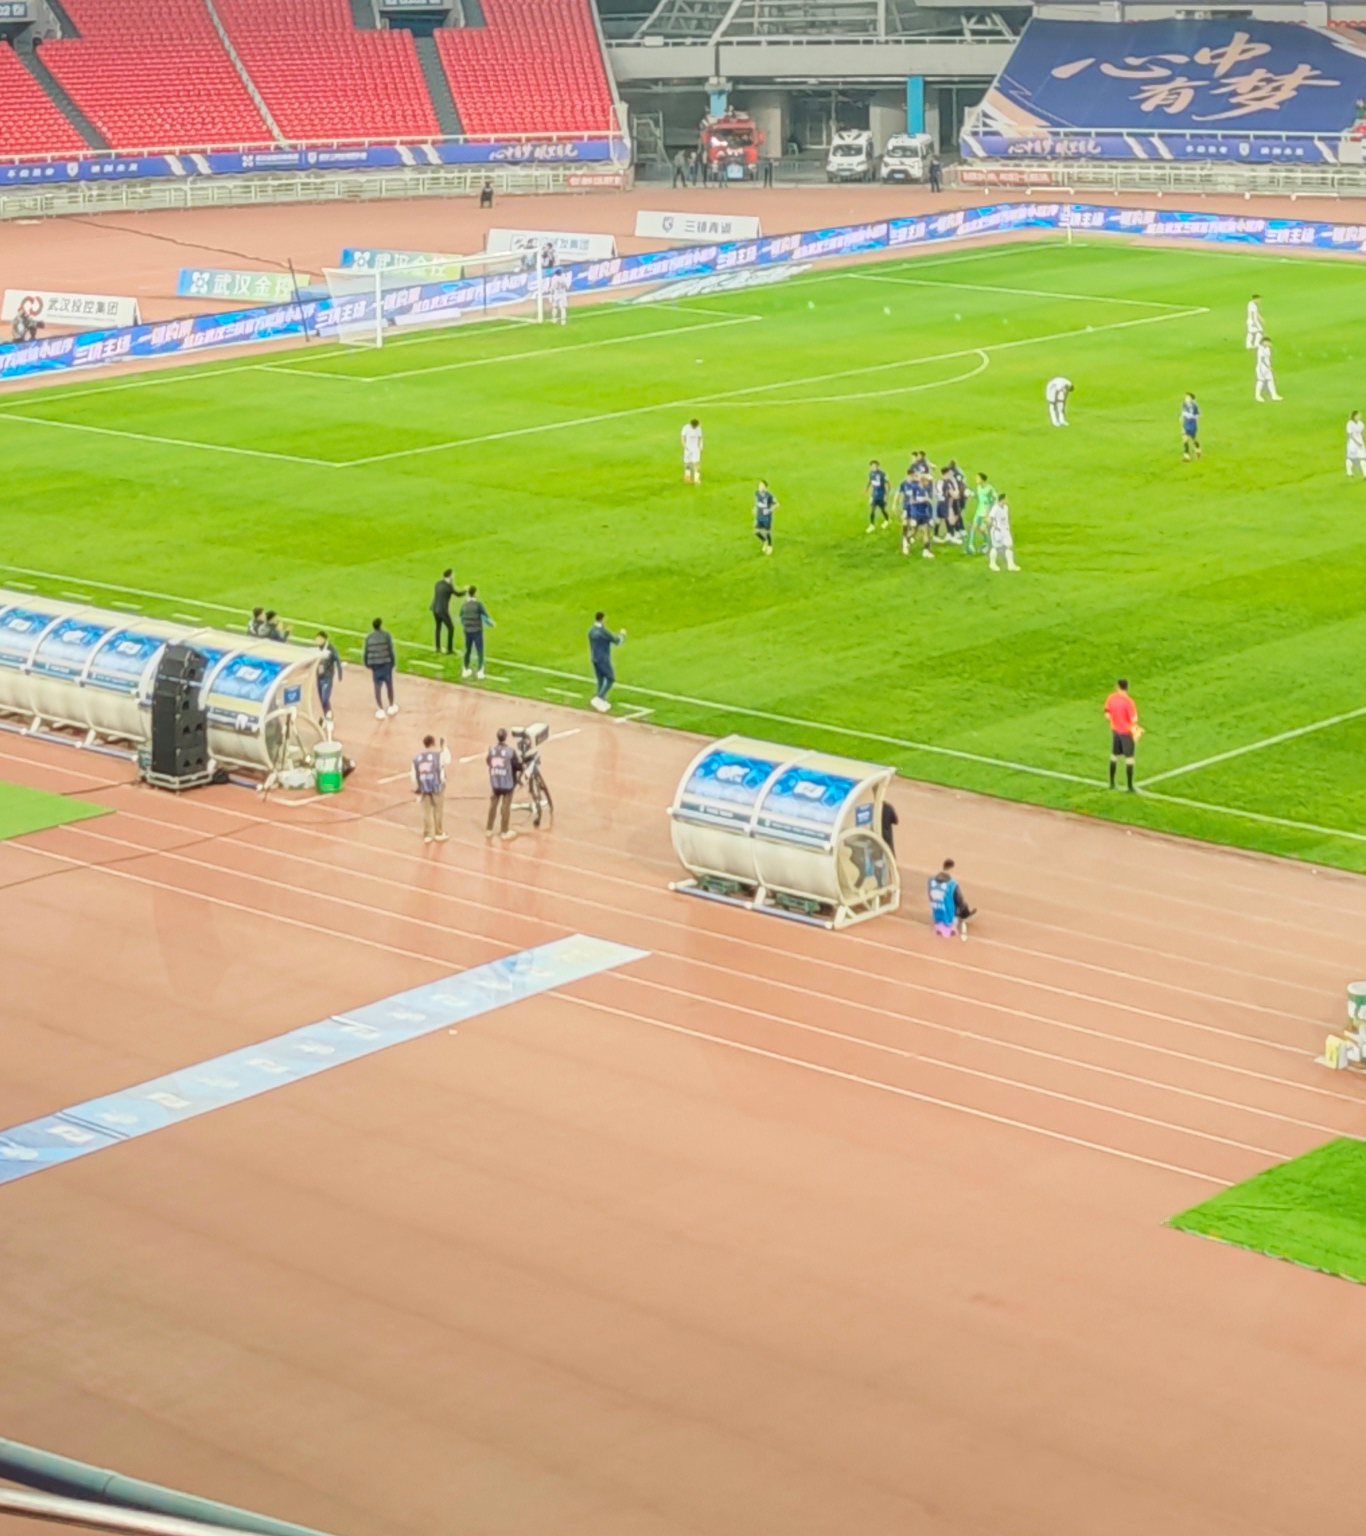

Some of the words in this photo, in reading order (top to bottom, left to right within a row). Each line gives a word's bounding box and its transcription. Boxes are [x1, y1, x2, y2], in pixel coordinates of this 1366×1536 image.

[1051, 31, 1273, 81] 心中
[1129, 62, 1341, 122] 有梦
[684, 219, 732, 235] 三镇青训
[213, 273, 292, 299] 武汉金控
[72, 334, 131, 365] 三镇主场
